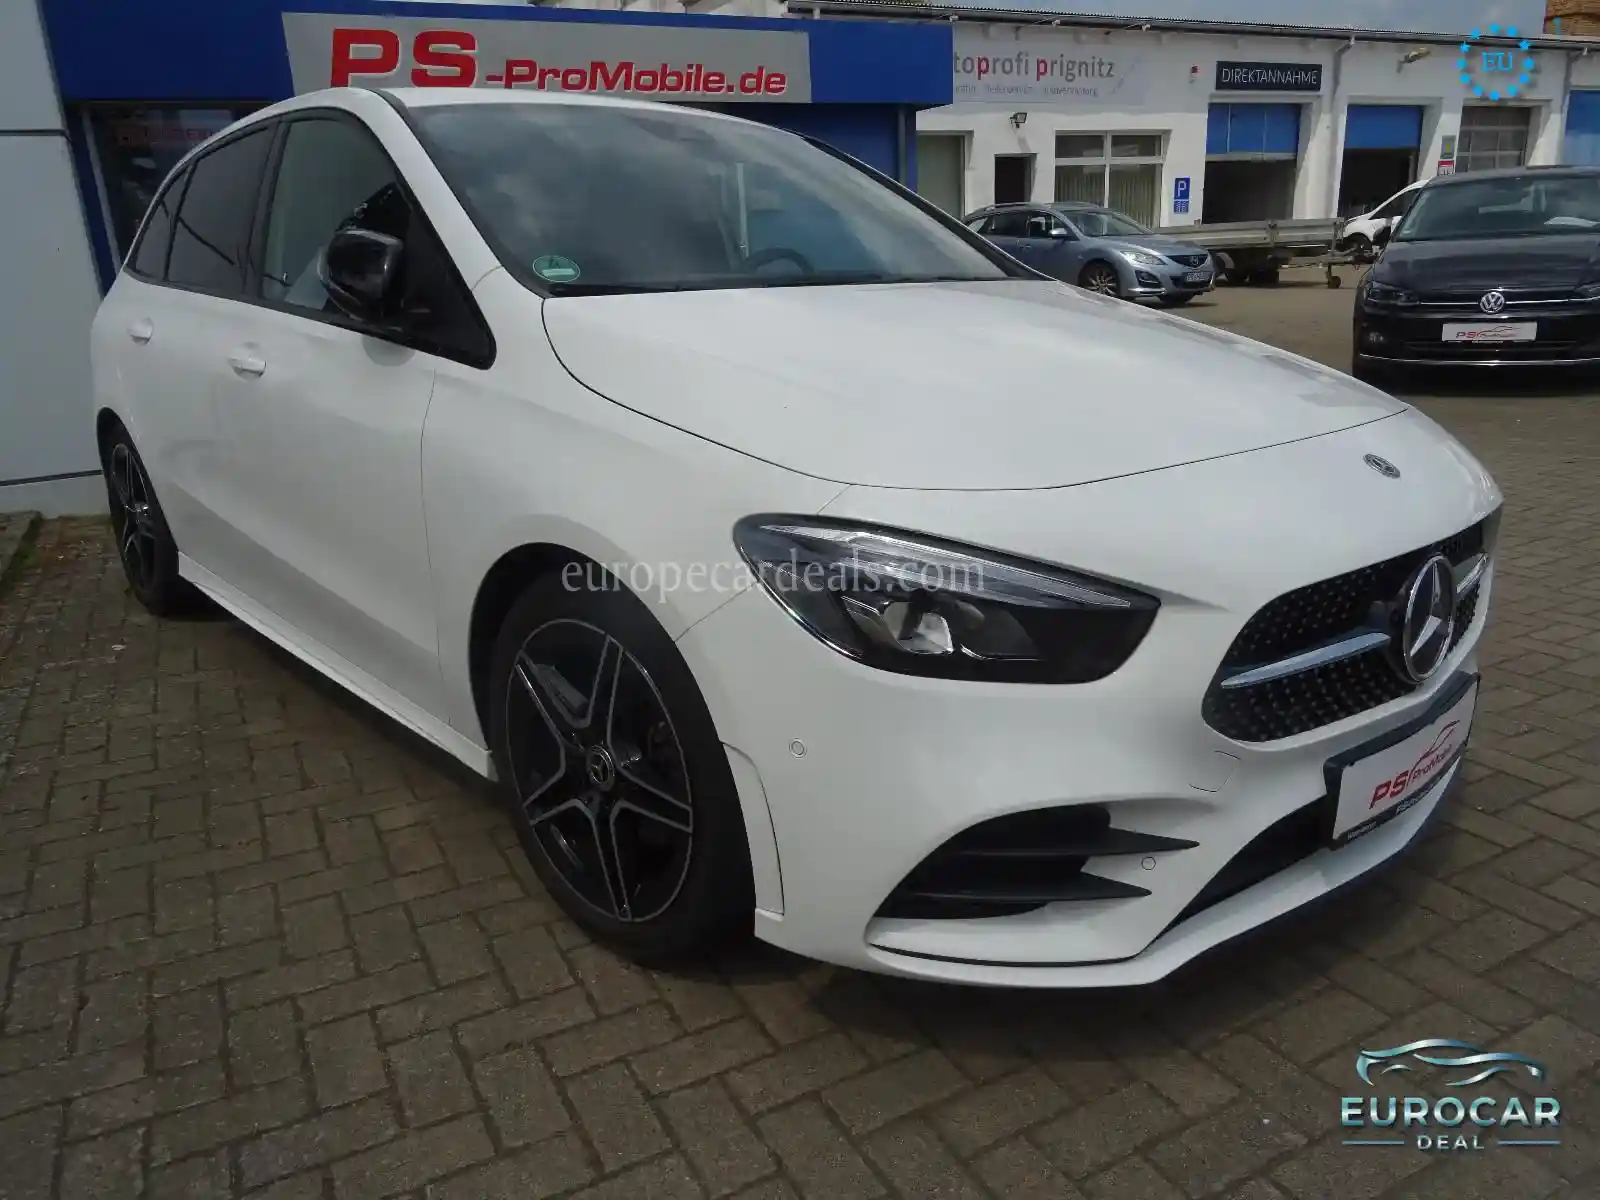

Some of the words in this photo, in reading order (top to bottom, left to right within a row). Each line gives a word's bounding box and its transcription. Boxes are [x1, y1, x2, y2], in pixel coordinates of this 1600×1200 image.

[1036, 54, 1116, 82] prignitz
[1221, 67, 1319, 85] DIREKTANNAHME
[1177, 180, 1188, 198] P
[1369, 770, 1410, 810] PS
